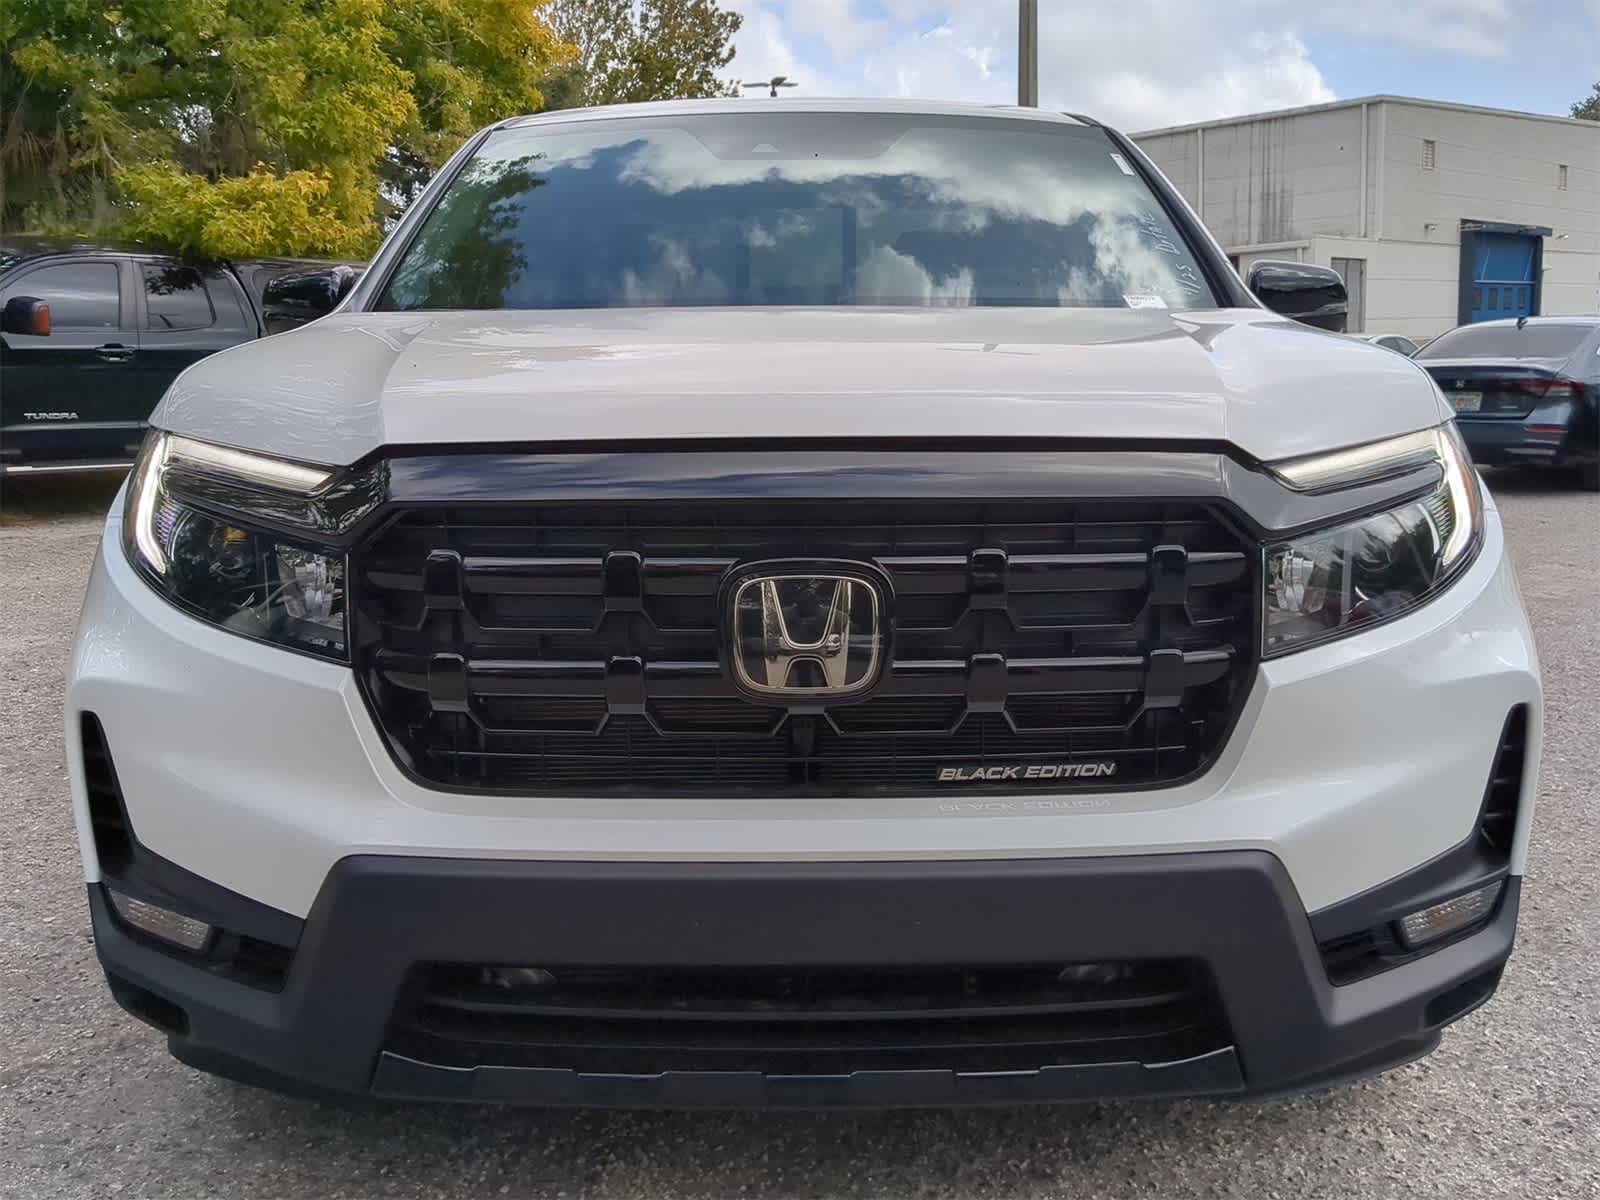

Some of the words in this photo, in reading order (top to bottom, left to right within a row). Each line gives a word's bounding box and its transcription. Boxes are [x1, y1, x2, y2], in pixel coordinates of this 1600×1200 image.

[23, 412, 79, 420] TUNDRA
[938, 767, 1021, 781] BLACK
[1024, 763, 1116, 778] EDITION
